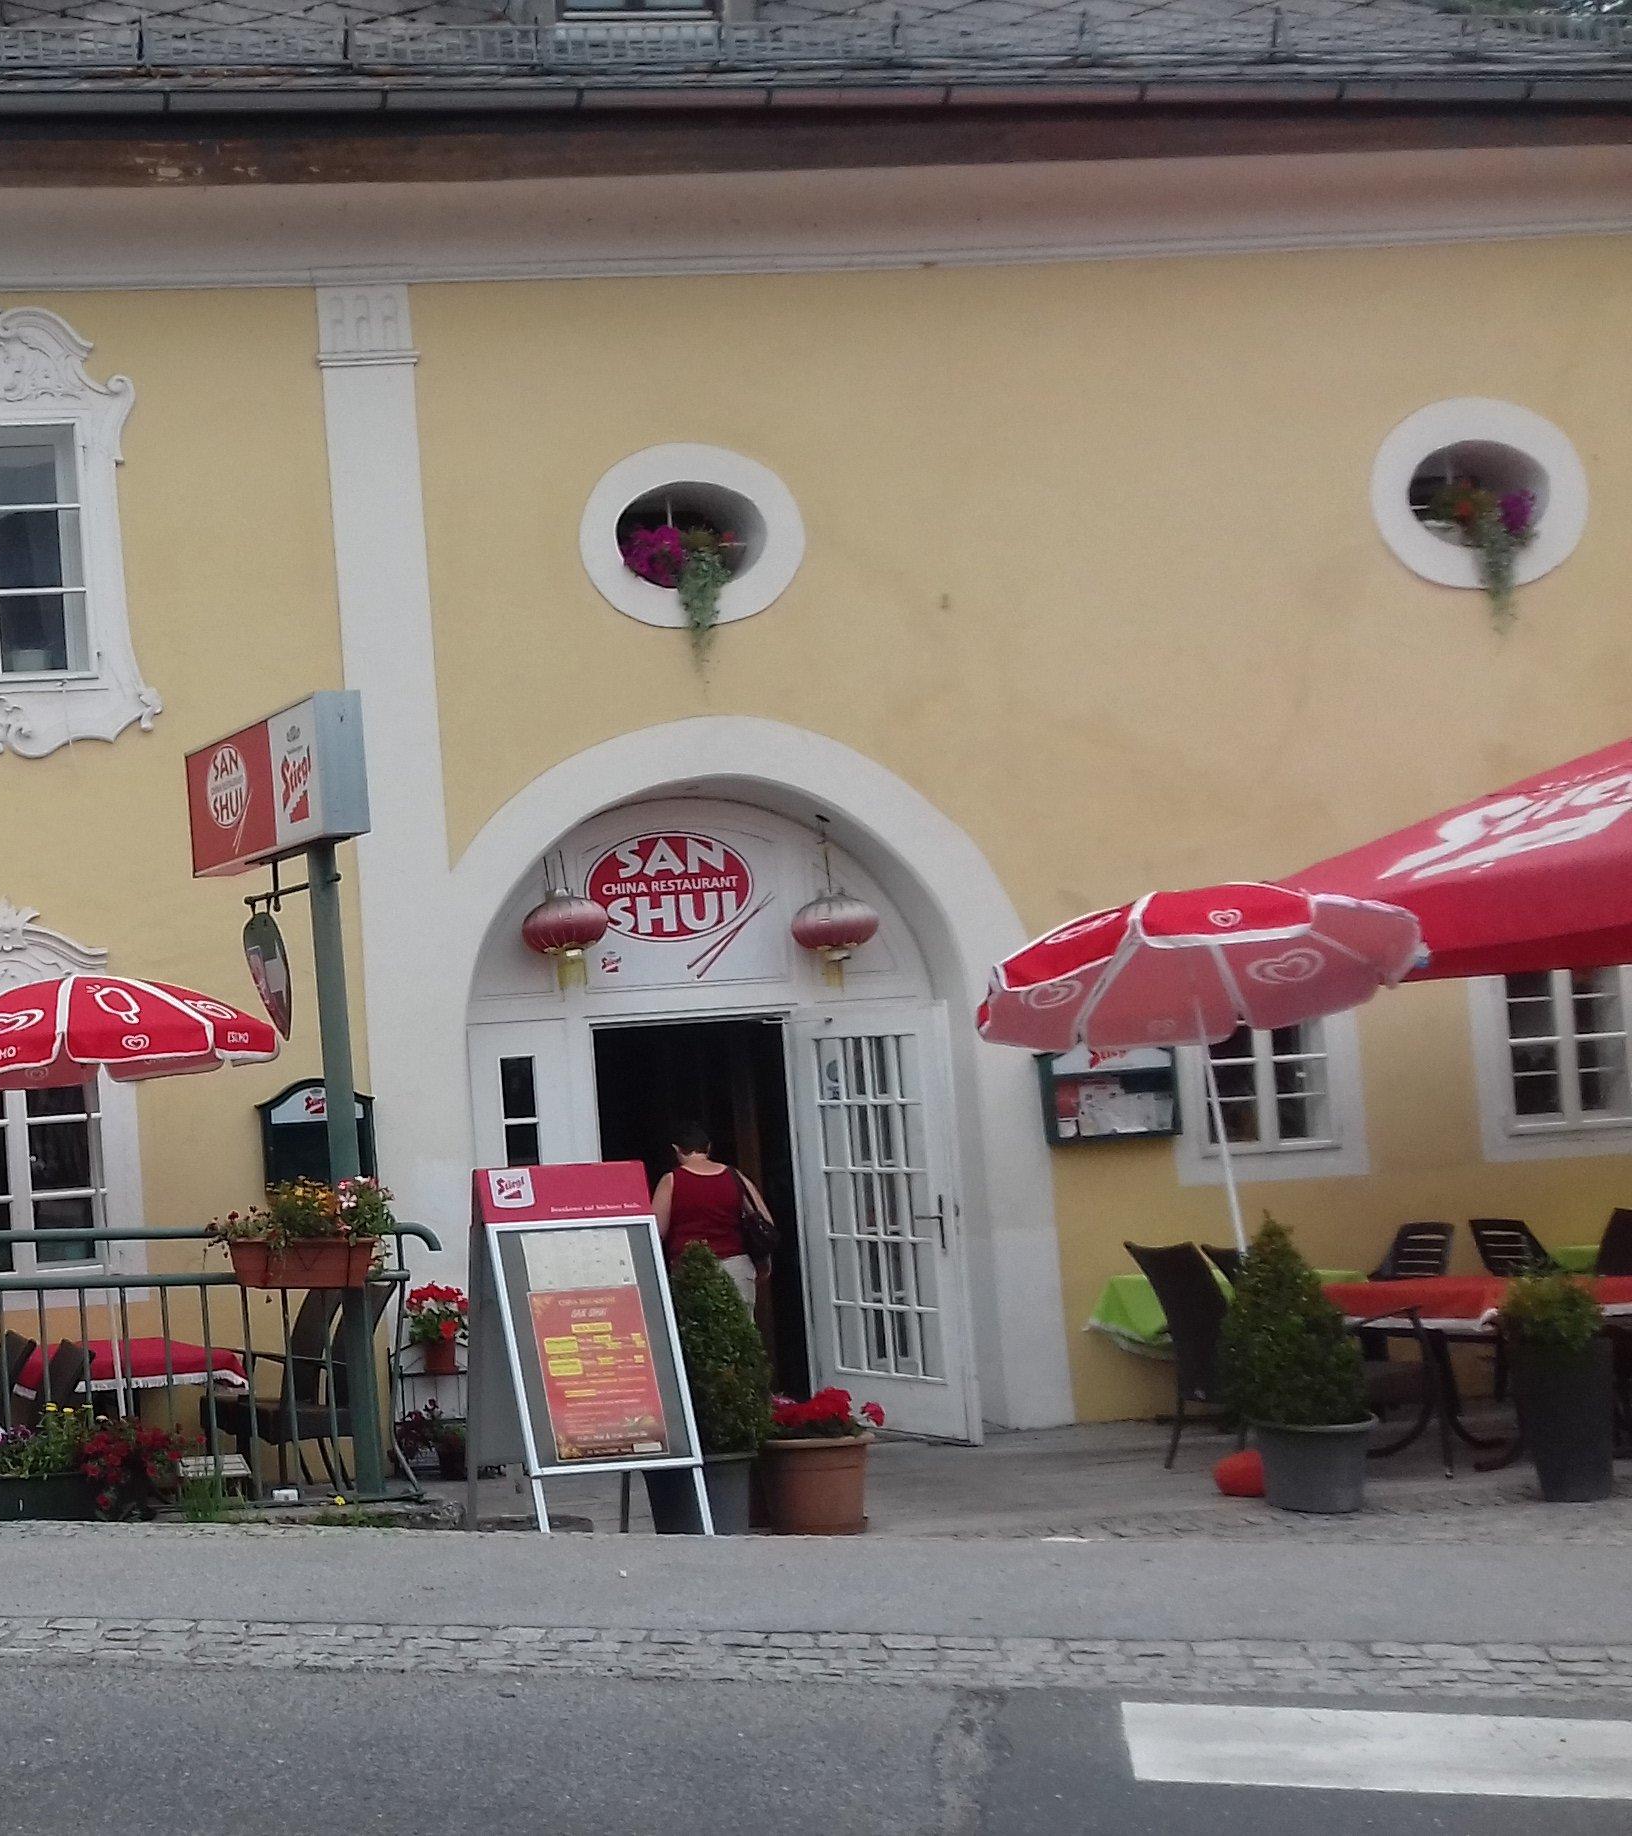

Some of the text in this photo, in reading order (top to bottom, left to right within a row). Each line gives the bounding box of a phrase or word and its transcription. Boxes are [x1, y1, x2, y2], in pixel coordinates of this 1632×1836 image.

[213, 748, 239, 781] SAN
[281, 745, 311, 813] Stiegl
[212, 787, 244, 821] SHUI
[614, 837, 726, 878] SAN
[601, 875, 738, 896] CHINA RESTAURANT
[606, 891, 738, 934] SHUI
